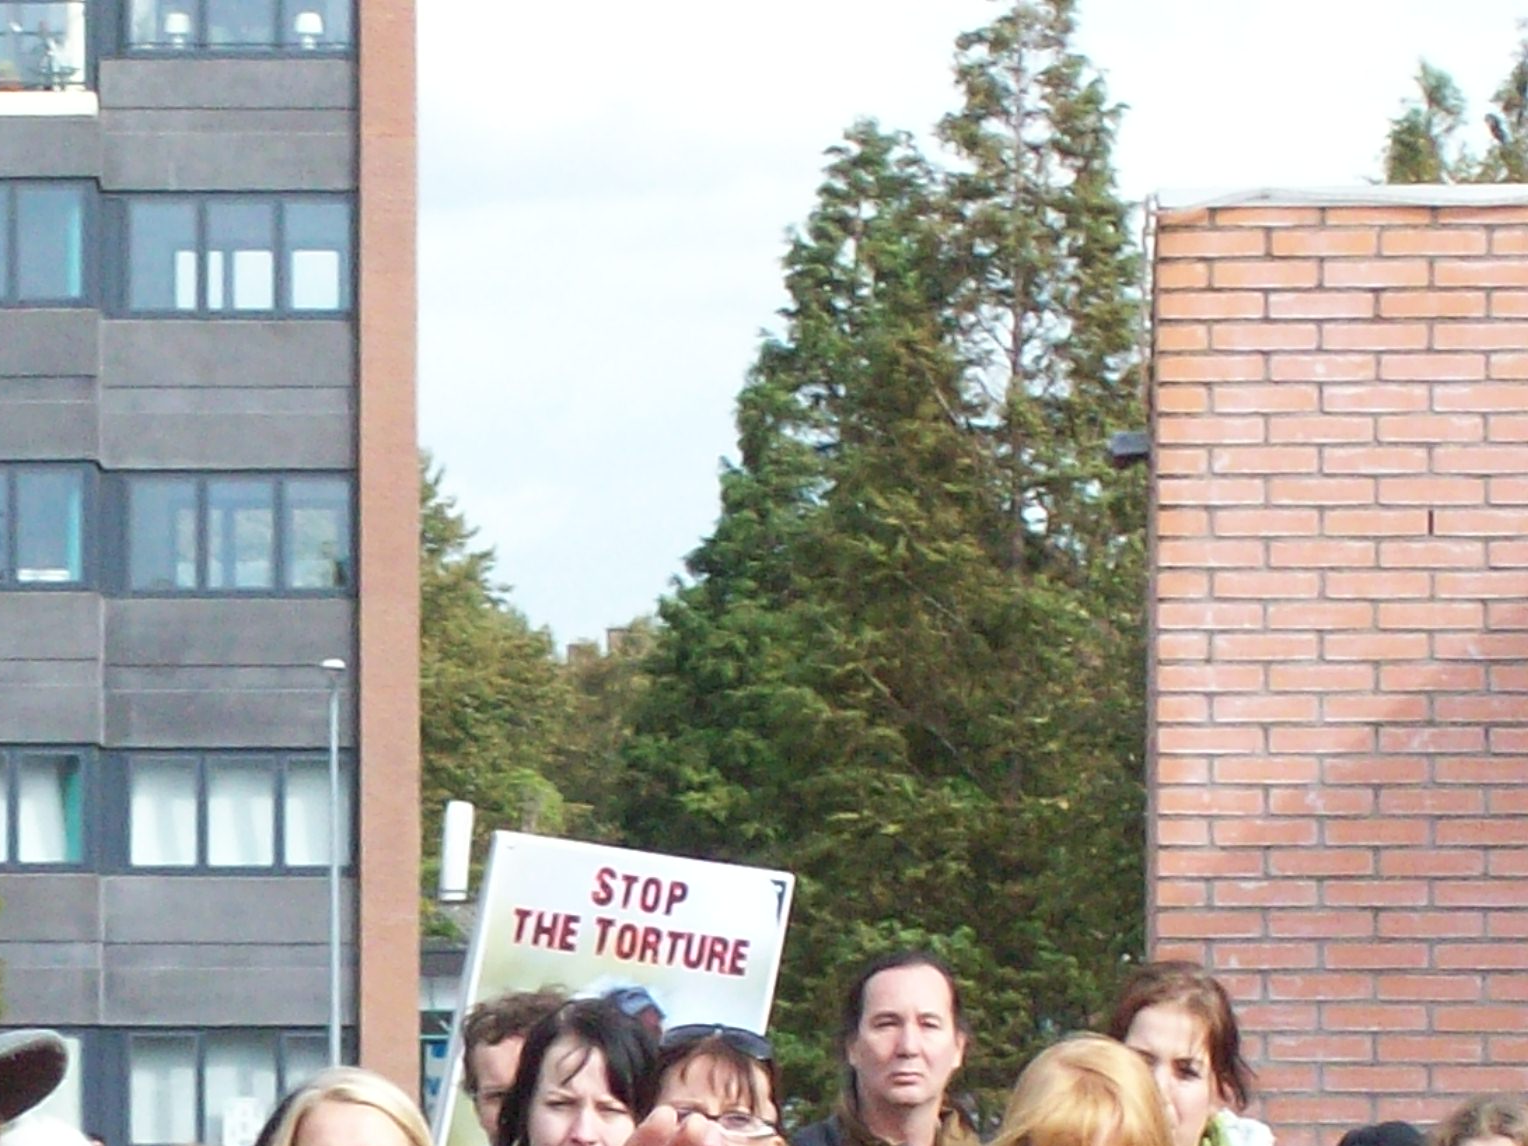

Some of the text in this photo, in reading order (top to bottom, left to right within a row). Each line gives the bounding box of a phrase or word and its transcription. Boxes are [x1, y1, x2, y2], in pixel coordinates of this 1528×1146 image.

[591, 866, 689, 917] STOP
[513, 907, 751, 977] THE TORTURE
